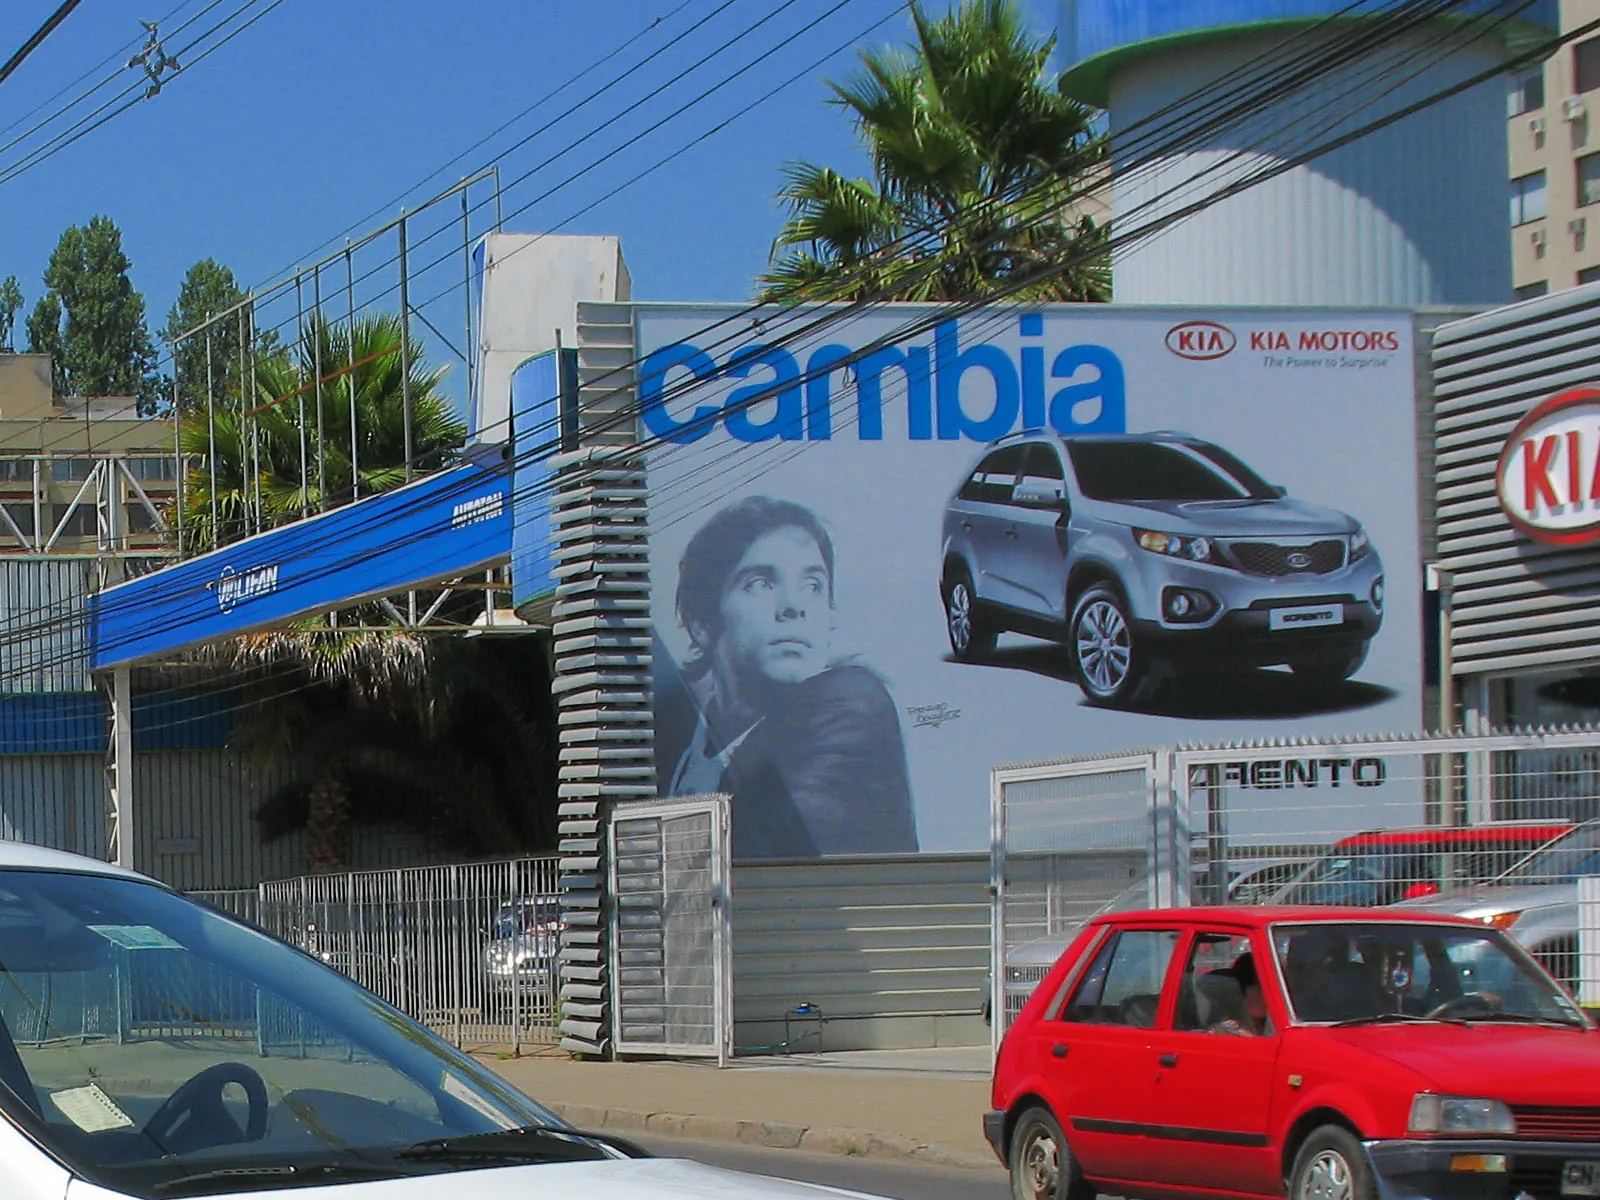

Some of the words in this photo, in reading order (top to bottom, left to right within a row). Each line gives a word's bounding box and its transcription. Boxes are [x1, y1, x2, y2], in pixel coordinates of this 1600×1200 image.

[1178, 330, 1225, 351] KIA
[1250, 330, 1291, 351] KIA
[1298, 330, 1400, 351] MOTORS
[1263, 356, 1284, 368] The
[1286, 356, 1323, 368] Power
[1325, 357, 1338, 368] to
[1339, 356, 1388, 369] Surprise
[639, 311, 1127, 444] cambia
